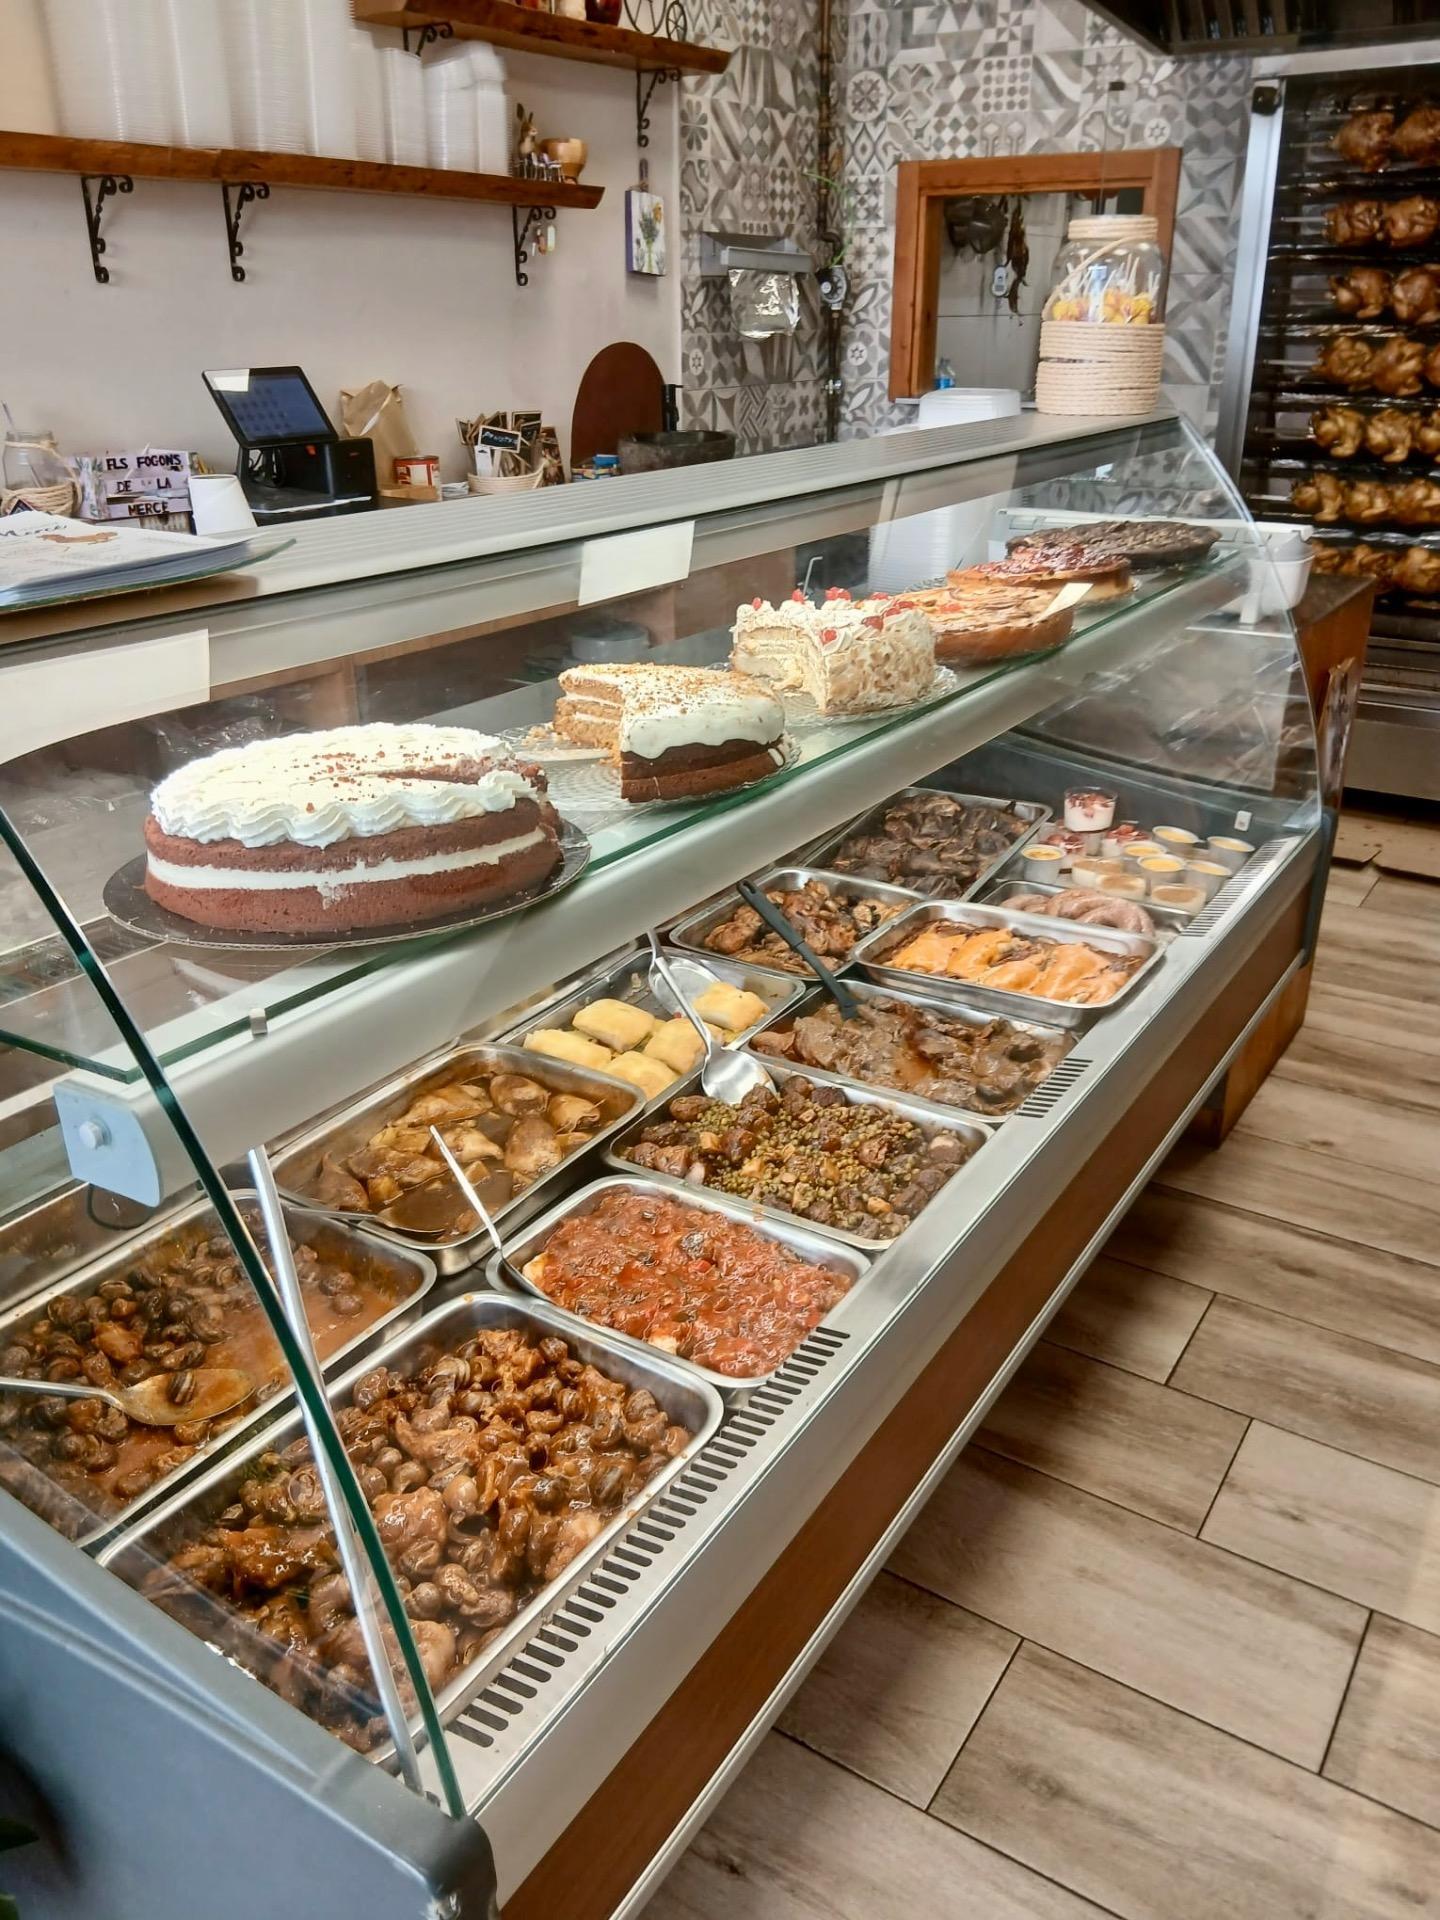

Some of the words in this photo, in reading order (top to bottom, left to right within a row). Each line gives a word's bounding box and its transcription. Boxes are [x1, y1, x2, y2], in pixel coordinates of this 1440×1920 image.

[136, 454, 182, 468] FOGONS
[116, 480, 132, 493] DE
[156, 477, 172, 490] LA
